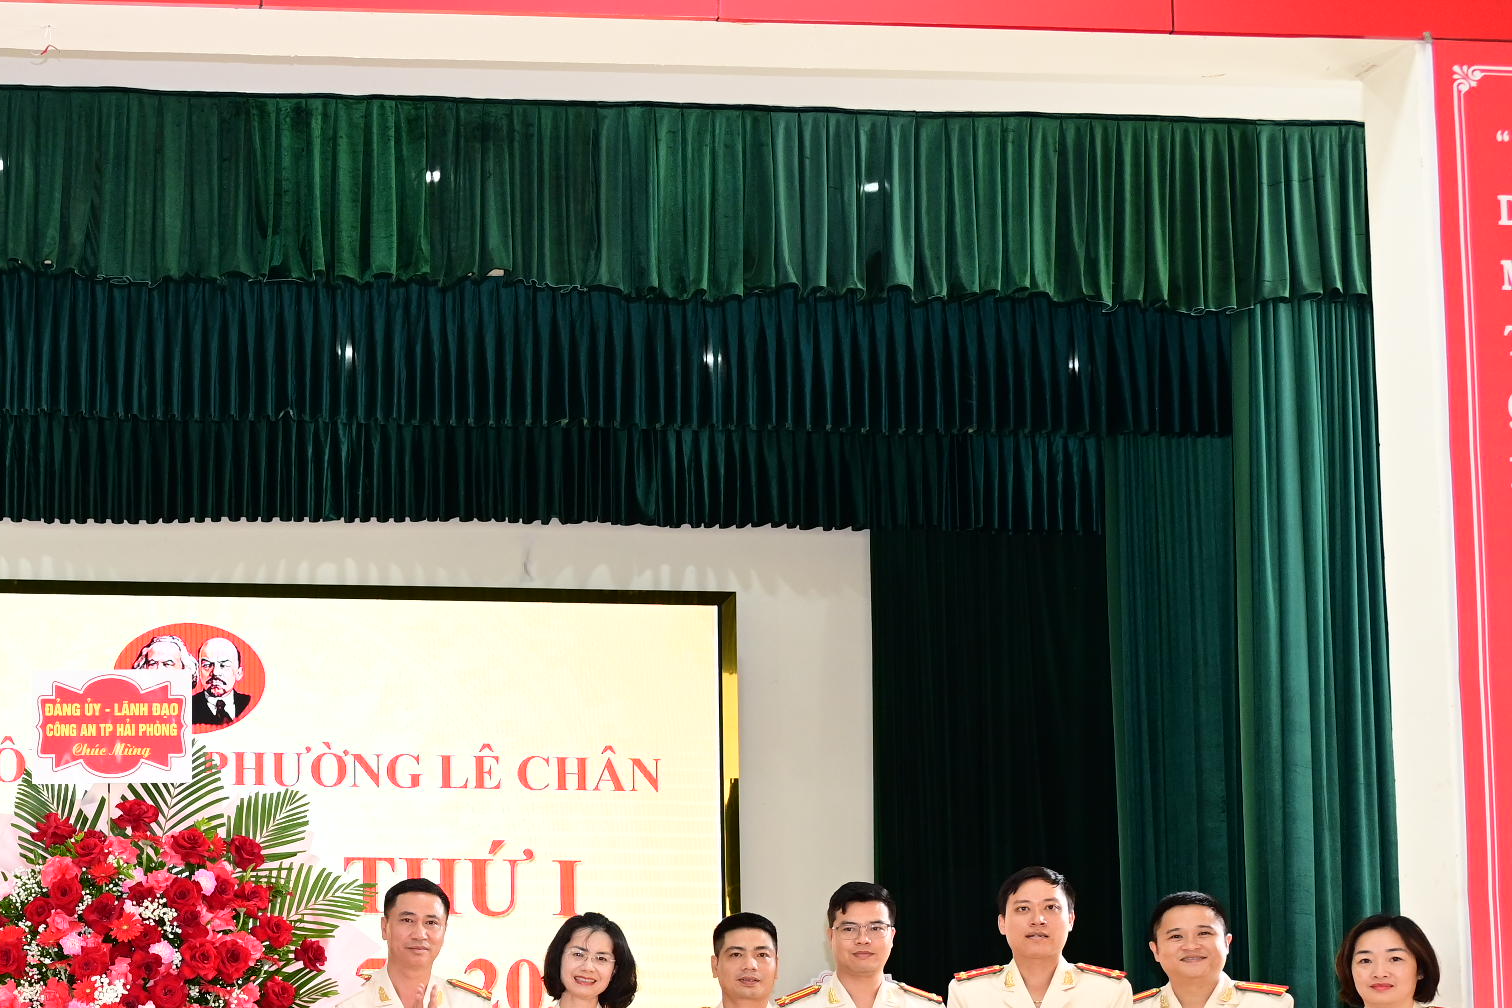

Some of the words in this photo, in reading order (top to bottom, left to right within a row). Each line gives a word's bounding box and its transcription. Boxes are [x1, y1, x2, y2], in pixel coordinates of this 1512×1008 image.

[45, 699, 81, 716] ĐẢNG
[85, 698, 101, 716] ỦY
[114, 701, 149, 716] LÃNH
[152, 703, 179, 719] ĐẠO
[46, 722, 77, 737] CÔNG
[80, 724, 97, 737] AN
[99, 724, 114, 737] TP
[117, 719, 136, 737] HẢI
[139, 720, 178, 737] PHÒNG
[73, 743, 106, 756] Chúc
[108, 742, 151, 758] Mừng
[440, 743, 501, 790] LÊ
[517, 745, 661, 793] CHÂN
